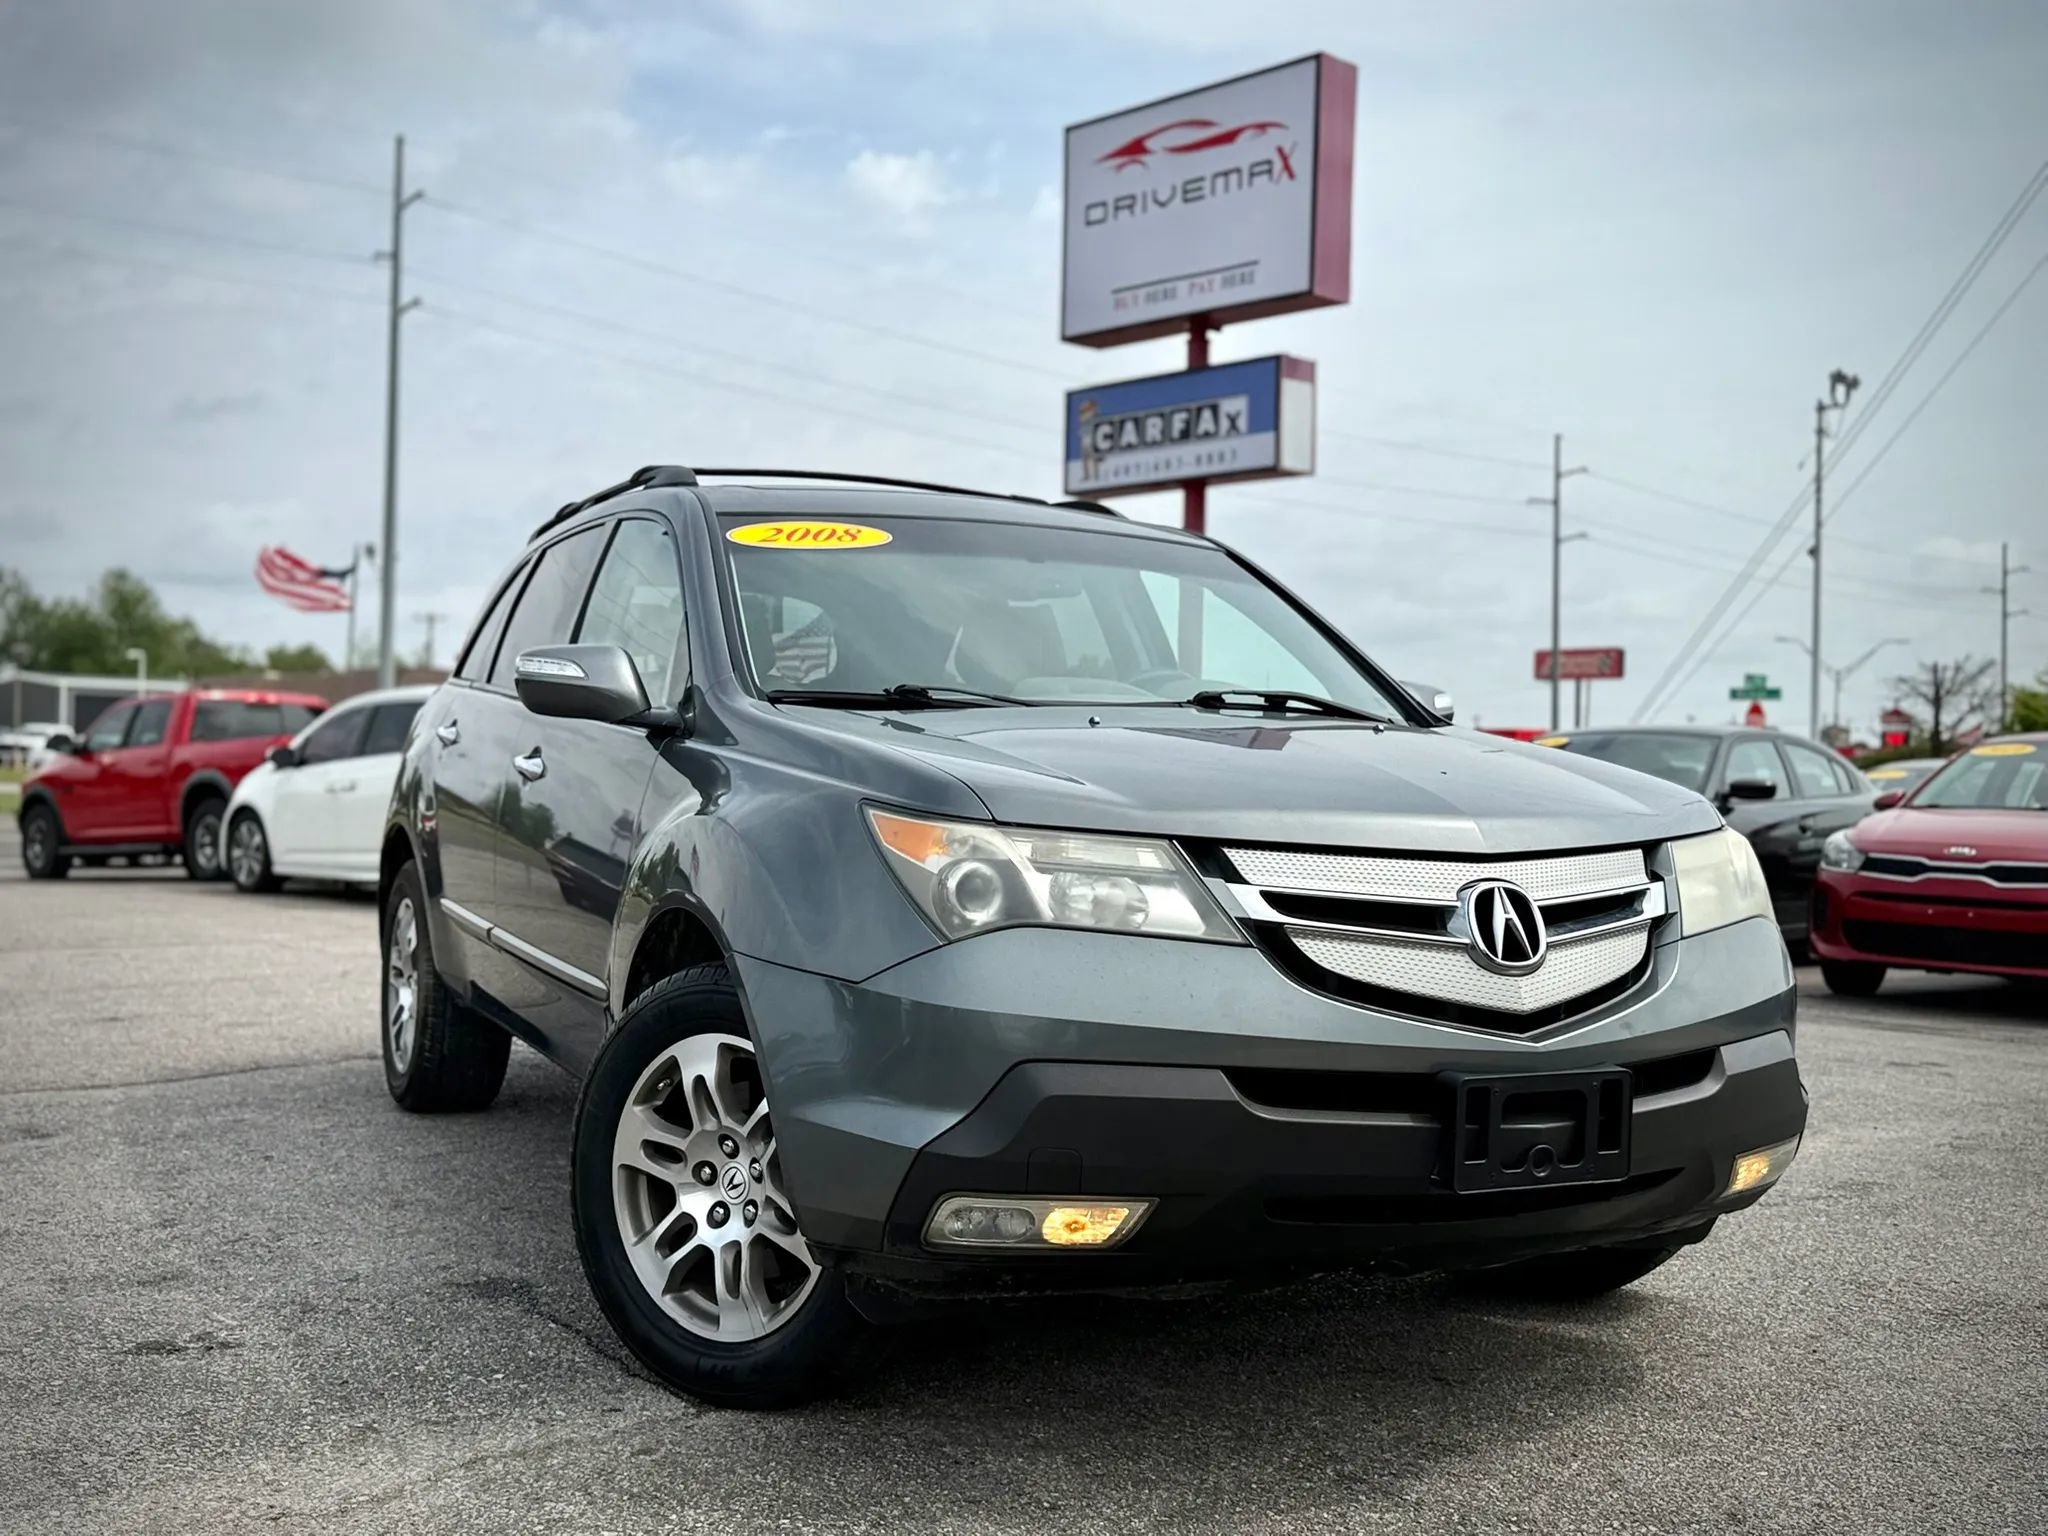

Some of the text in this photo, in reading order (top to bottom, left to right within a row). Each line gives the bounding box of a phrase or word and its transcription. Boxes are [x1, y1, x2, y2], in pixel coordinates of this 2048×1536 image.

[1084, 140, 1297, 227] DRIVEMAX
[1095, 404, 1244, 451] CARFAX
[757, 527, 862, 543] 2008
